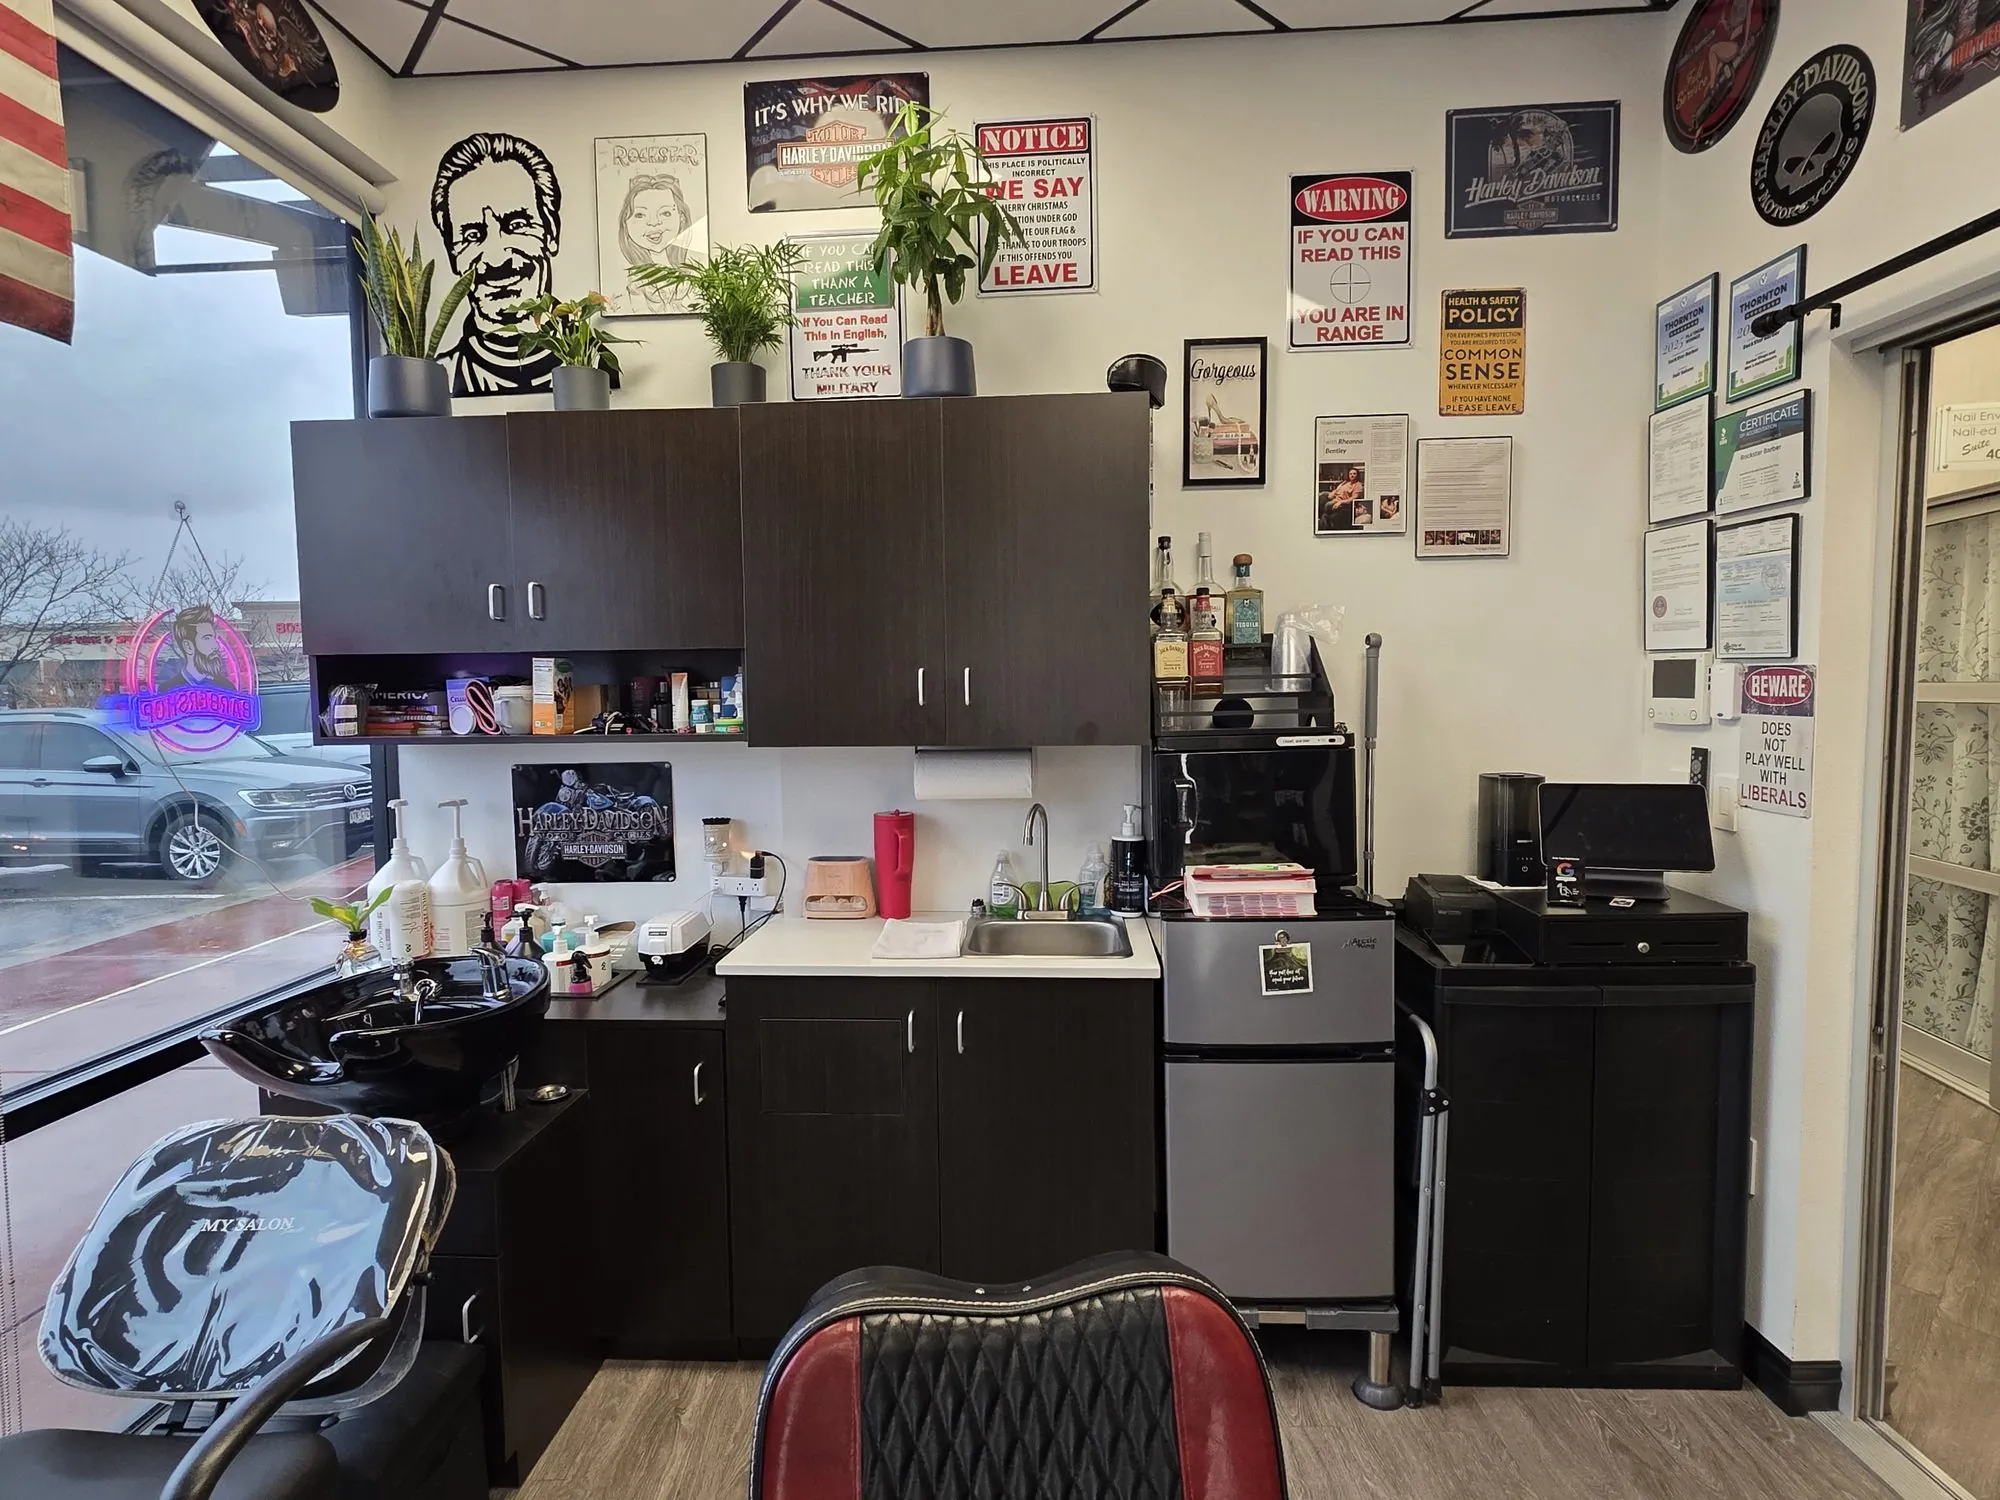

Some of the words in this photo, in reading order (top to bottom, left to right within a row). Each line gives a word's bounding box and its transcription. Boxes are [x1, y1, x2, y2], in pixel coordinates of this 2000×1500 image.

[754, 102, 788, 127] IT'S
[791, 95, 836, 117] WHY
[839, 94, 868, 111] WE
[1755, 53, 1869, 186] HARLEY-DAVIDSON
[983, 125, 1084, 152] NOTICE
[612, 144, 699, 167] ROCKSTAR
[985, 161, 999, 169] HIS
[1001, 160, 1026, 168] PLACE
[1028, 159, 1035, 167] IS
[1037, 157, 1086, 166] POLITICALLY
[1012, 169, 1056, 177] INCORRECT
[1757, 137, 1858, 219] MOTORCYCLES
[985, 179, 1024, 199] WE
[1033, 176, 1084, 198] SAY
[1465, 165, 1602, 202] Harley-Davidson
[1303, 187, 1399, 213] WARNING
[1545, 193, 1601, 202] MOTORCYCLES
[1001, 203, 1025, 212] MERRY
[1027, 200, 1068, 211] CHRISTMAS
[1036, 214, 1062, 223] UNDER
[1062, 213, 1078, 222] GOD
[1034, 227, 1049, 235] OUR
[1051, 226, 1069, 235] FLAG
[1070, 226, 1076, 234] &
[1298, 230, 1313, 244] IF
[1319, 228, 1359, 243] YOU
[1364, 226, 1404, 241] CAN
[1031, 240, 1041, 248] TO
[1042, 239, 1057, 248] OUR
[1058, 238, 1087, 247] TROOPS
[801, 246, 813, 258] IF
[820, 244, 845, 257] YOU
[999, 254, 1006, 262] IF
[1007, 254, 1024, 262] THIS
[1025, 252, 1057, 261] OFFENDS
[1057, 252, 1073, 260] YOU
[1301, 248, 1353, 263] READ
[1359, 246, 1401, 260] THIS
[804, 261, 840, 274] READ
[845, 259, 875, 272] THIS
[994, 263, 1078, 285] LEAVE
[811, 276, 858, 290] THANK
[864, 277, 873, 288] A
[809, 292, 875, 307] TEACHER
[1449, 297, 1479, 306] HEALTH
[1481, 296, 1488, 304] &
[1490, 296, 1519, 304] SAFETY
[1739, 283, 1788, 313] THORNTON
[803, 316, 810, 327] If
[812, 316, 833, 327] You
[836, 315, 857, 325] Can
[860, 314, 888, 325] Read
[1297, 308, 1336, 324] YOU
[1340, 306, 1380, 322] ARE
[1386, 305, 1404, 320] IN
[1449, 307, 1519, 323] POLICY
[1664, 305, 1704, 332] THORNTON
[804, 331, 827, 342] This
[830, 330, 840, 340] In
[843, 328, 887, 340] English,
[1316, 325, 1384, 342] RANGE
[1444, 348, 1522, 360] COMMON
[802, 366, 848, 379] THANK
[853, 365, 892, 377] YOUR
[1191, 358, 1256, 386] Gorgeous
[1445, 362, 1520, 380] SENSE
[816, 381, 880, 395] MILITARY
[1446, 404, 1482, 412] PLEASE
[1486, 403, 1516, 411] LEAVE
[1739, 403, 1799, 432] CERTIFICATE
[1953, 412, 1976, 422] Nail
[1952, 426, 1997, 437] Nail-ed
[1961, 439, 1990, 456] Suite
[1751, 674, 1806, 698] BEWARE
[1761, 721, 1791, 736] DOES
[1764, 738, 1787, 752] NOT
[1745, 752, 1772, 767] PLAY
[1774, 756, 1805, 771] WELL
[1760, 769, 1787, 785] WITH
[1741, 783, 1807, 809] LIBERALS
[517, 805, 669, 837] HARLEY-DAVIDSON
[564, 844, 624, 854] HARLEY-DAVIDSON
[200, 1219, 236, 1232] MY
[235, 1217, 296, 1231] SALON
